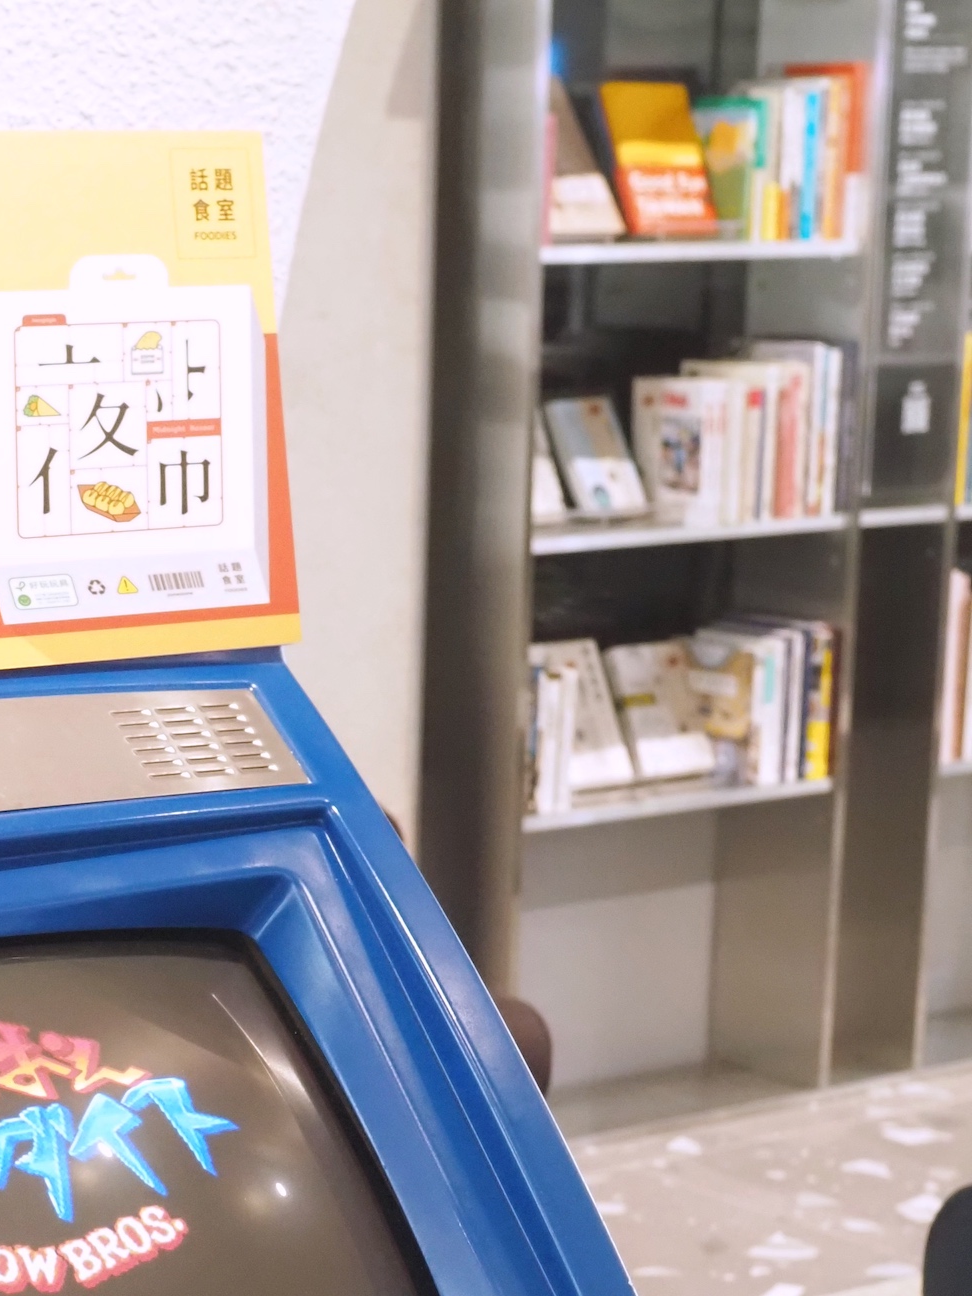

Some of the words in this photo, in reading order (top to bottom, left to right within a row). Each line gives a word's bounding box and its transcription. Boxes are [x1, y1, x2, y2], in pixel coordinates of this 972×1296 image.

[190, 168, 233, 191] 話題
[193, 198, 235, 222] 食室
[194, 231, 237, 241] FOODIES
